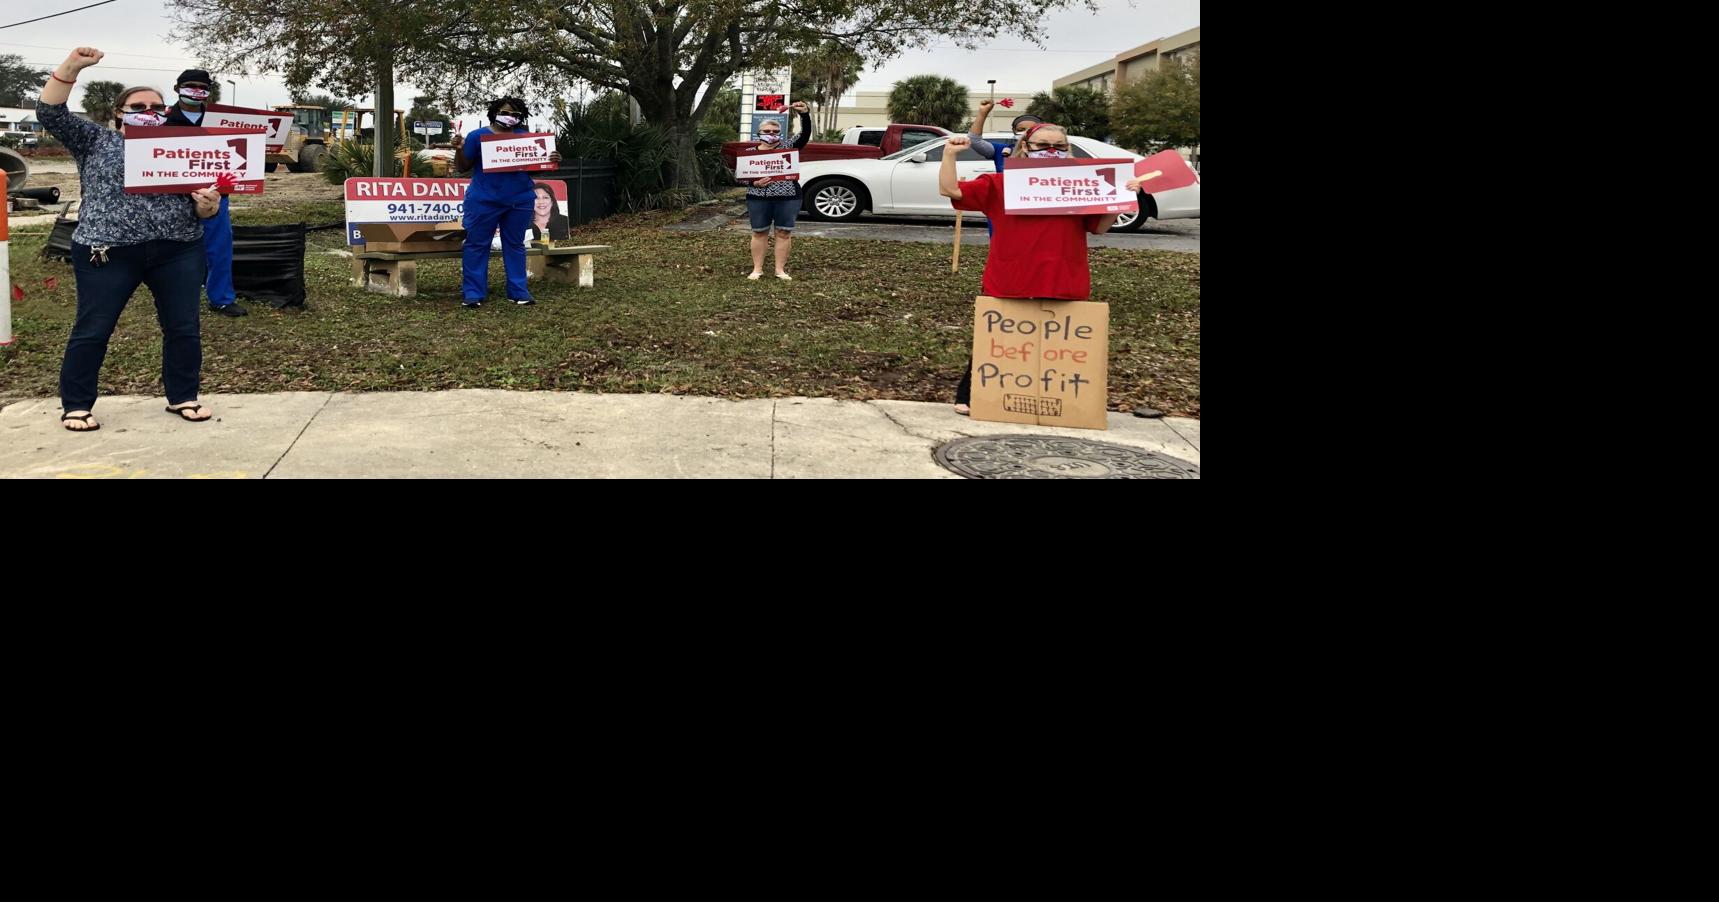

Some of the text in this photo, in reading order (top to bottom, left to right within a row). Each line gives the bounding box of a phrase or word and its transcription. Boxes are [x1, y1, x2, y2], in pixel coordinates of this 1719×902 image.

[220, 119, 268, 131] Patients
[153, 148, 231, 159] Patients
[188, 159, 231, 170] First
[182, 170, 246, 178] COMMUY
[1028, 175, 1100, 187] Patients
[356, 181, 470, 197] RITA DANT
[1061, 186, 1100, 196] First
[387, 203, 464, 214] 941-740-0
[982, 310, 1093, 340] People
[990, 338, 1088, 363] before
[977, 363, 1089, 398] Profit
